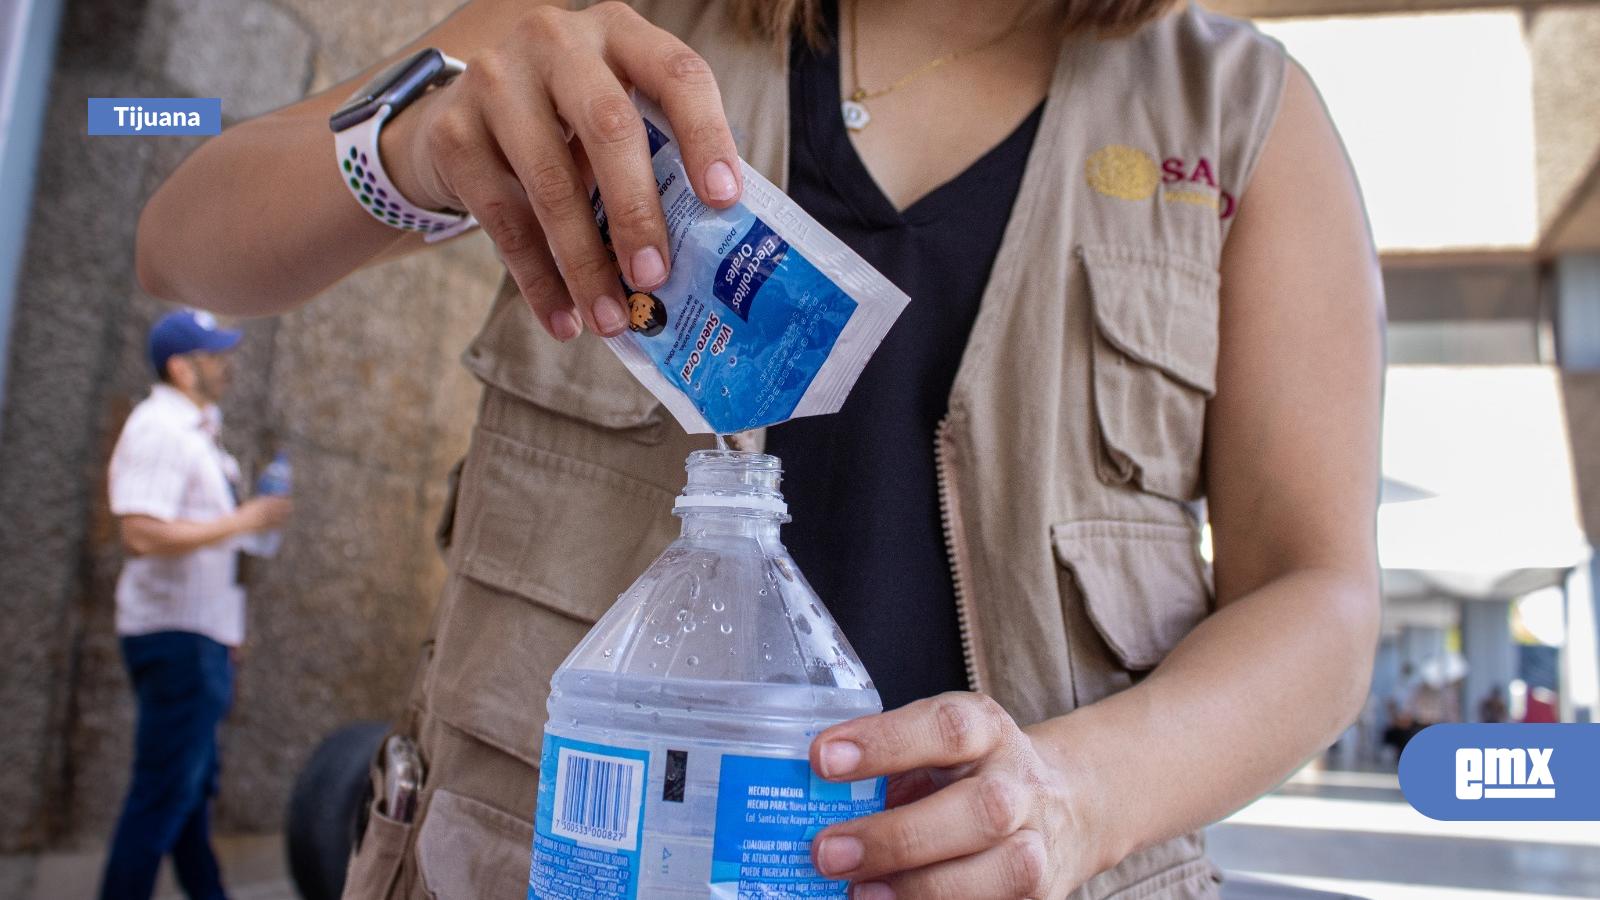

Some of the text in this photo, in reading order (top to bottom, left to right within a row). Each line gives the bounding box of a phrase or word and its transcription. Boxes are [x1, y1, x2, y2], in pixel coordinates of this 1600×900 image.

[658, 173, 677, 197] SOBR
[717, 226, 737, 255] polvo
[725, 243, 753, 286] Orales
[732, 239, 776, 309] Electrolitos
[681, 312, 720, 384] Suero Oral
[710, 324, 733, 355] Vida
[748, 785, 770, 797] HECHO
[770, 786, 780, 797] EN
[747, 799, 769, 810] HECHO
[758, 813, 775, 825] Santa
[776, 814, 791, 825] Cruz
[563, 823, 588, 836] 500533
[591, 827, 624, 842] 000827
[743, 839, 775, 851] CUALQUIER
[776, 840, 792, 851] DUDA
[742, 852, 751, 863] DE
[741, 866, 760, 877] PUEDE
[762, 867, 789, 878] INGRESAR
